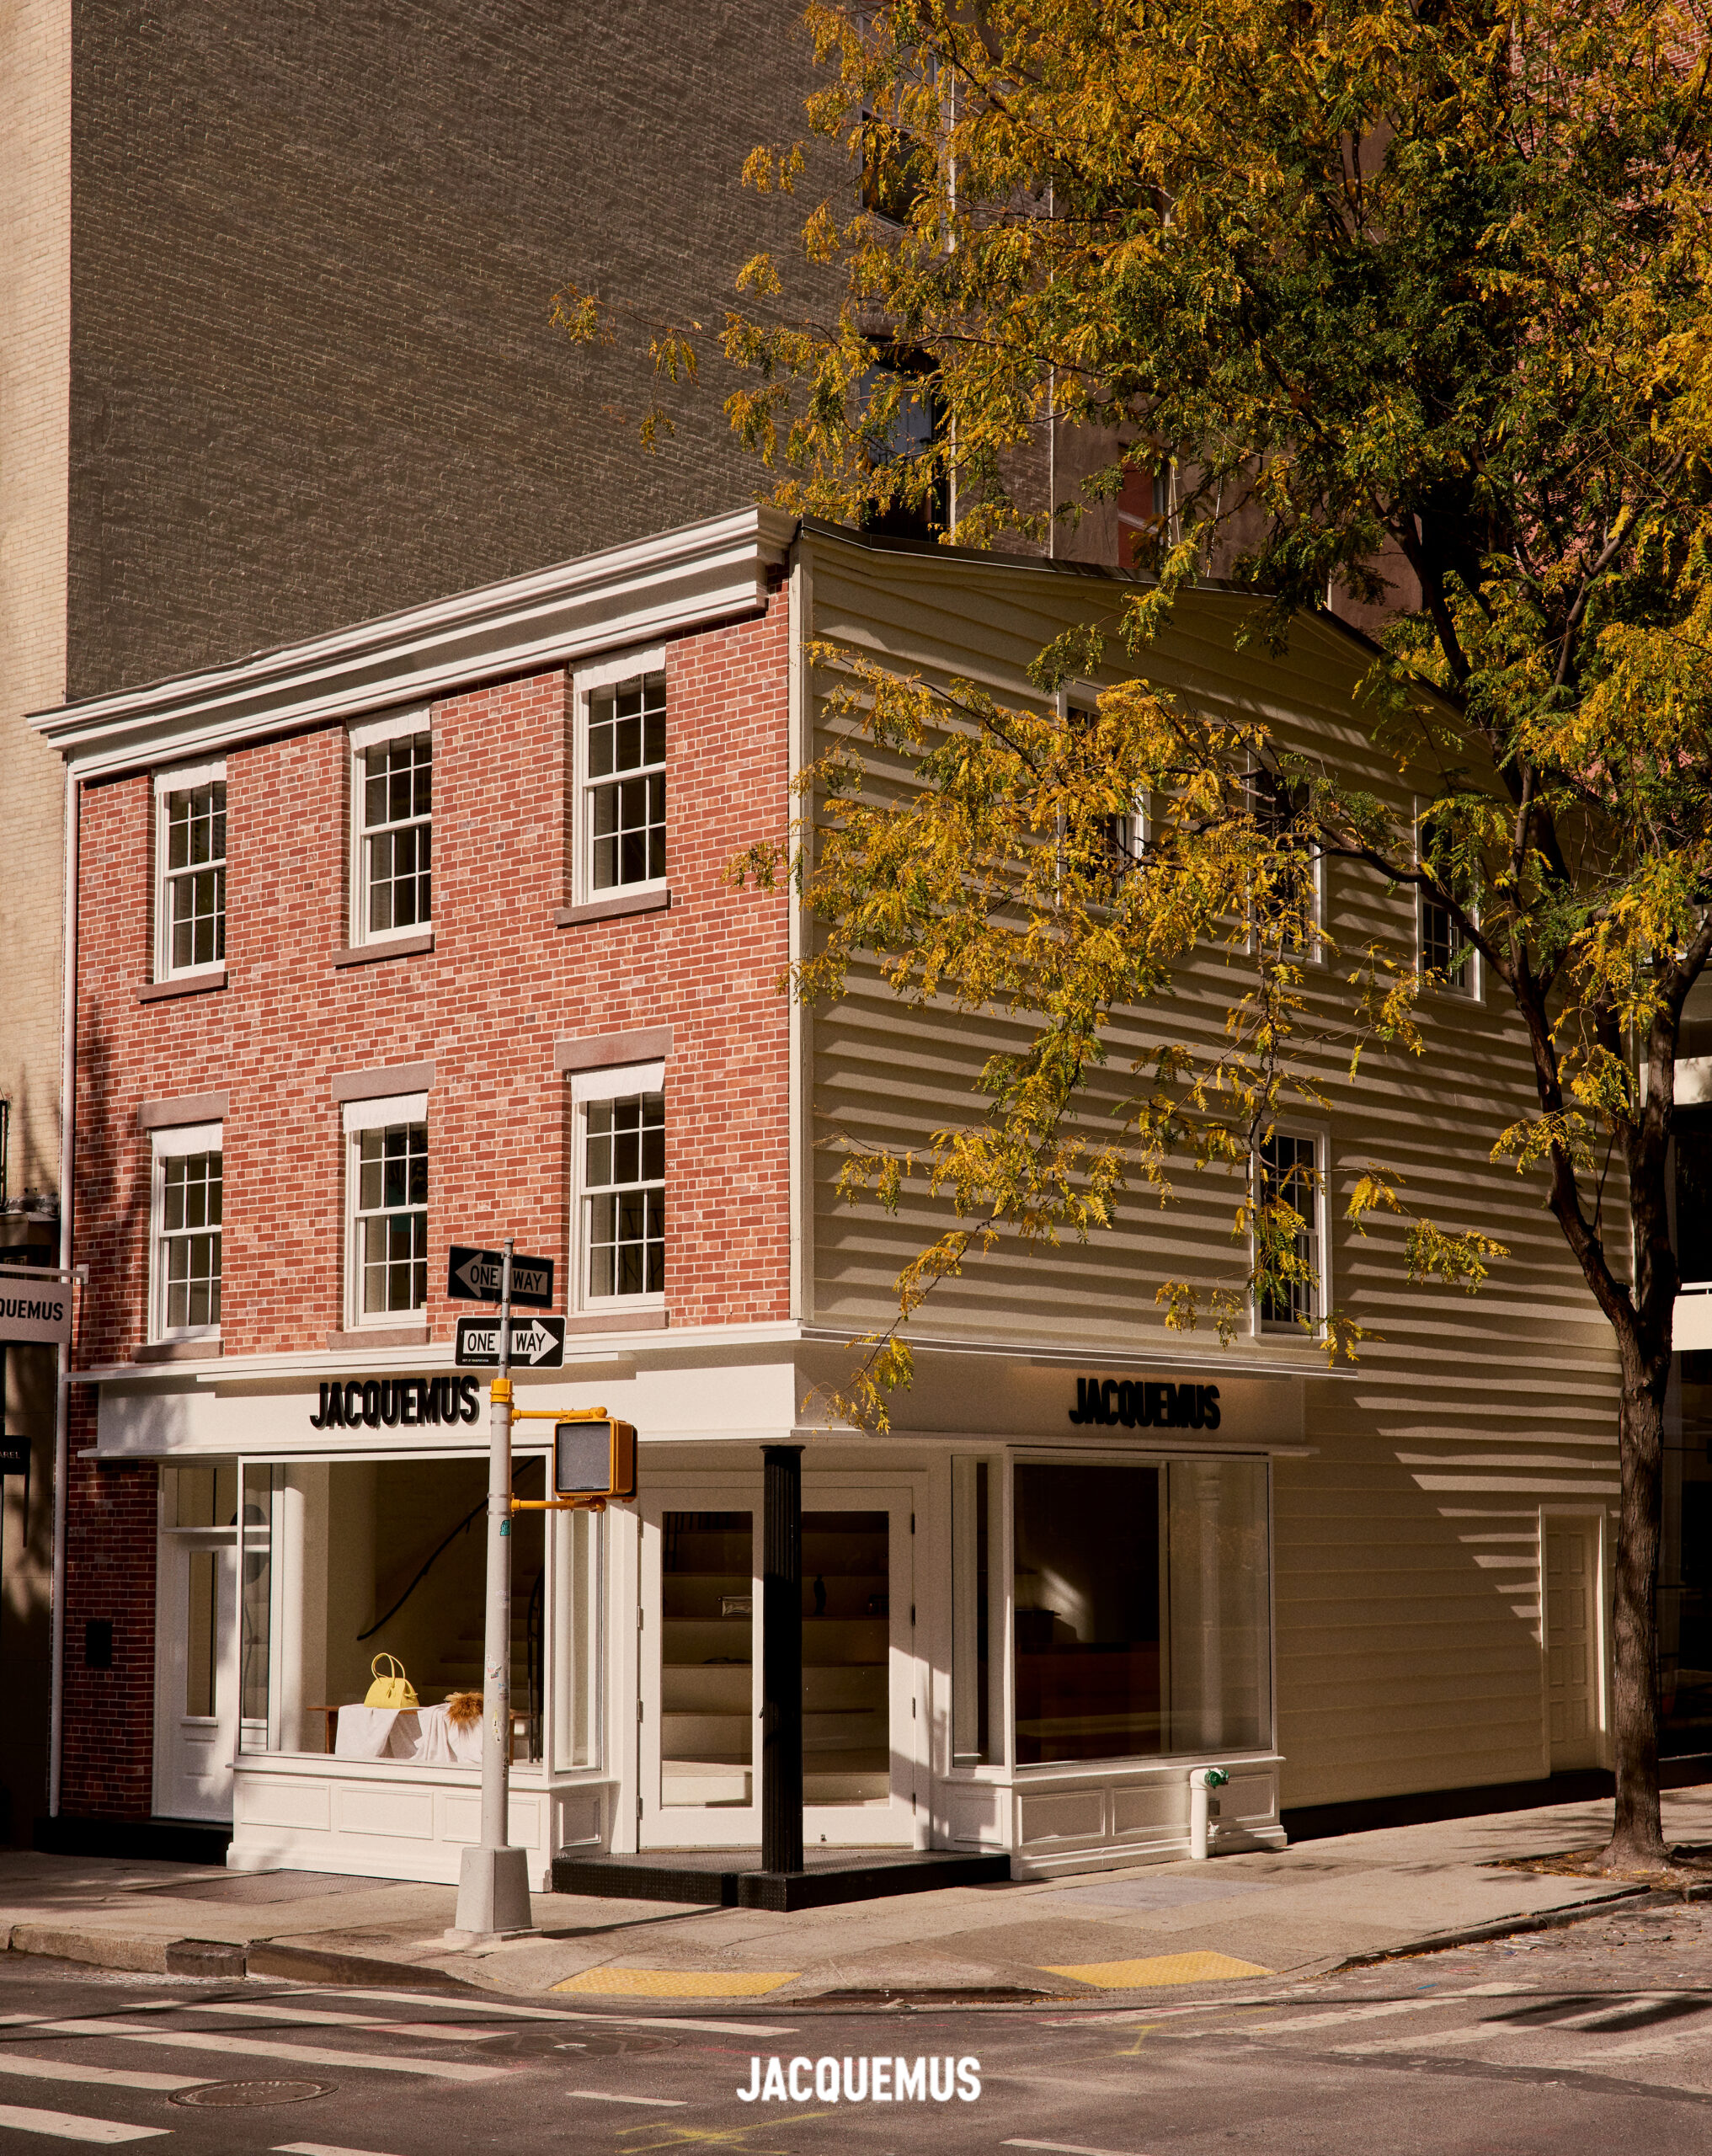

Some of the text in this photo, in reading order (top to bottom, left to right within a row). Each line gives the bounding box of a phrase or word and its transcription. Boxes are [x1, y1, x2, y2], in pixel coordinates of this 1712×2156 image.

[470, 1265, 543, 1291] ONE WAY
[467, 1333, 547, 1352] ONE WAY
[309, 1375, 480, 1429] JACQUEMUS
[1068, 1378, 1221, 1430] JACQUEMUS
